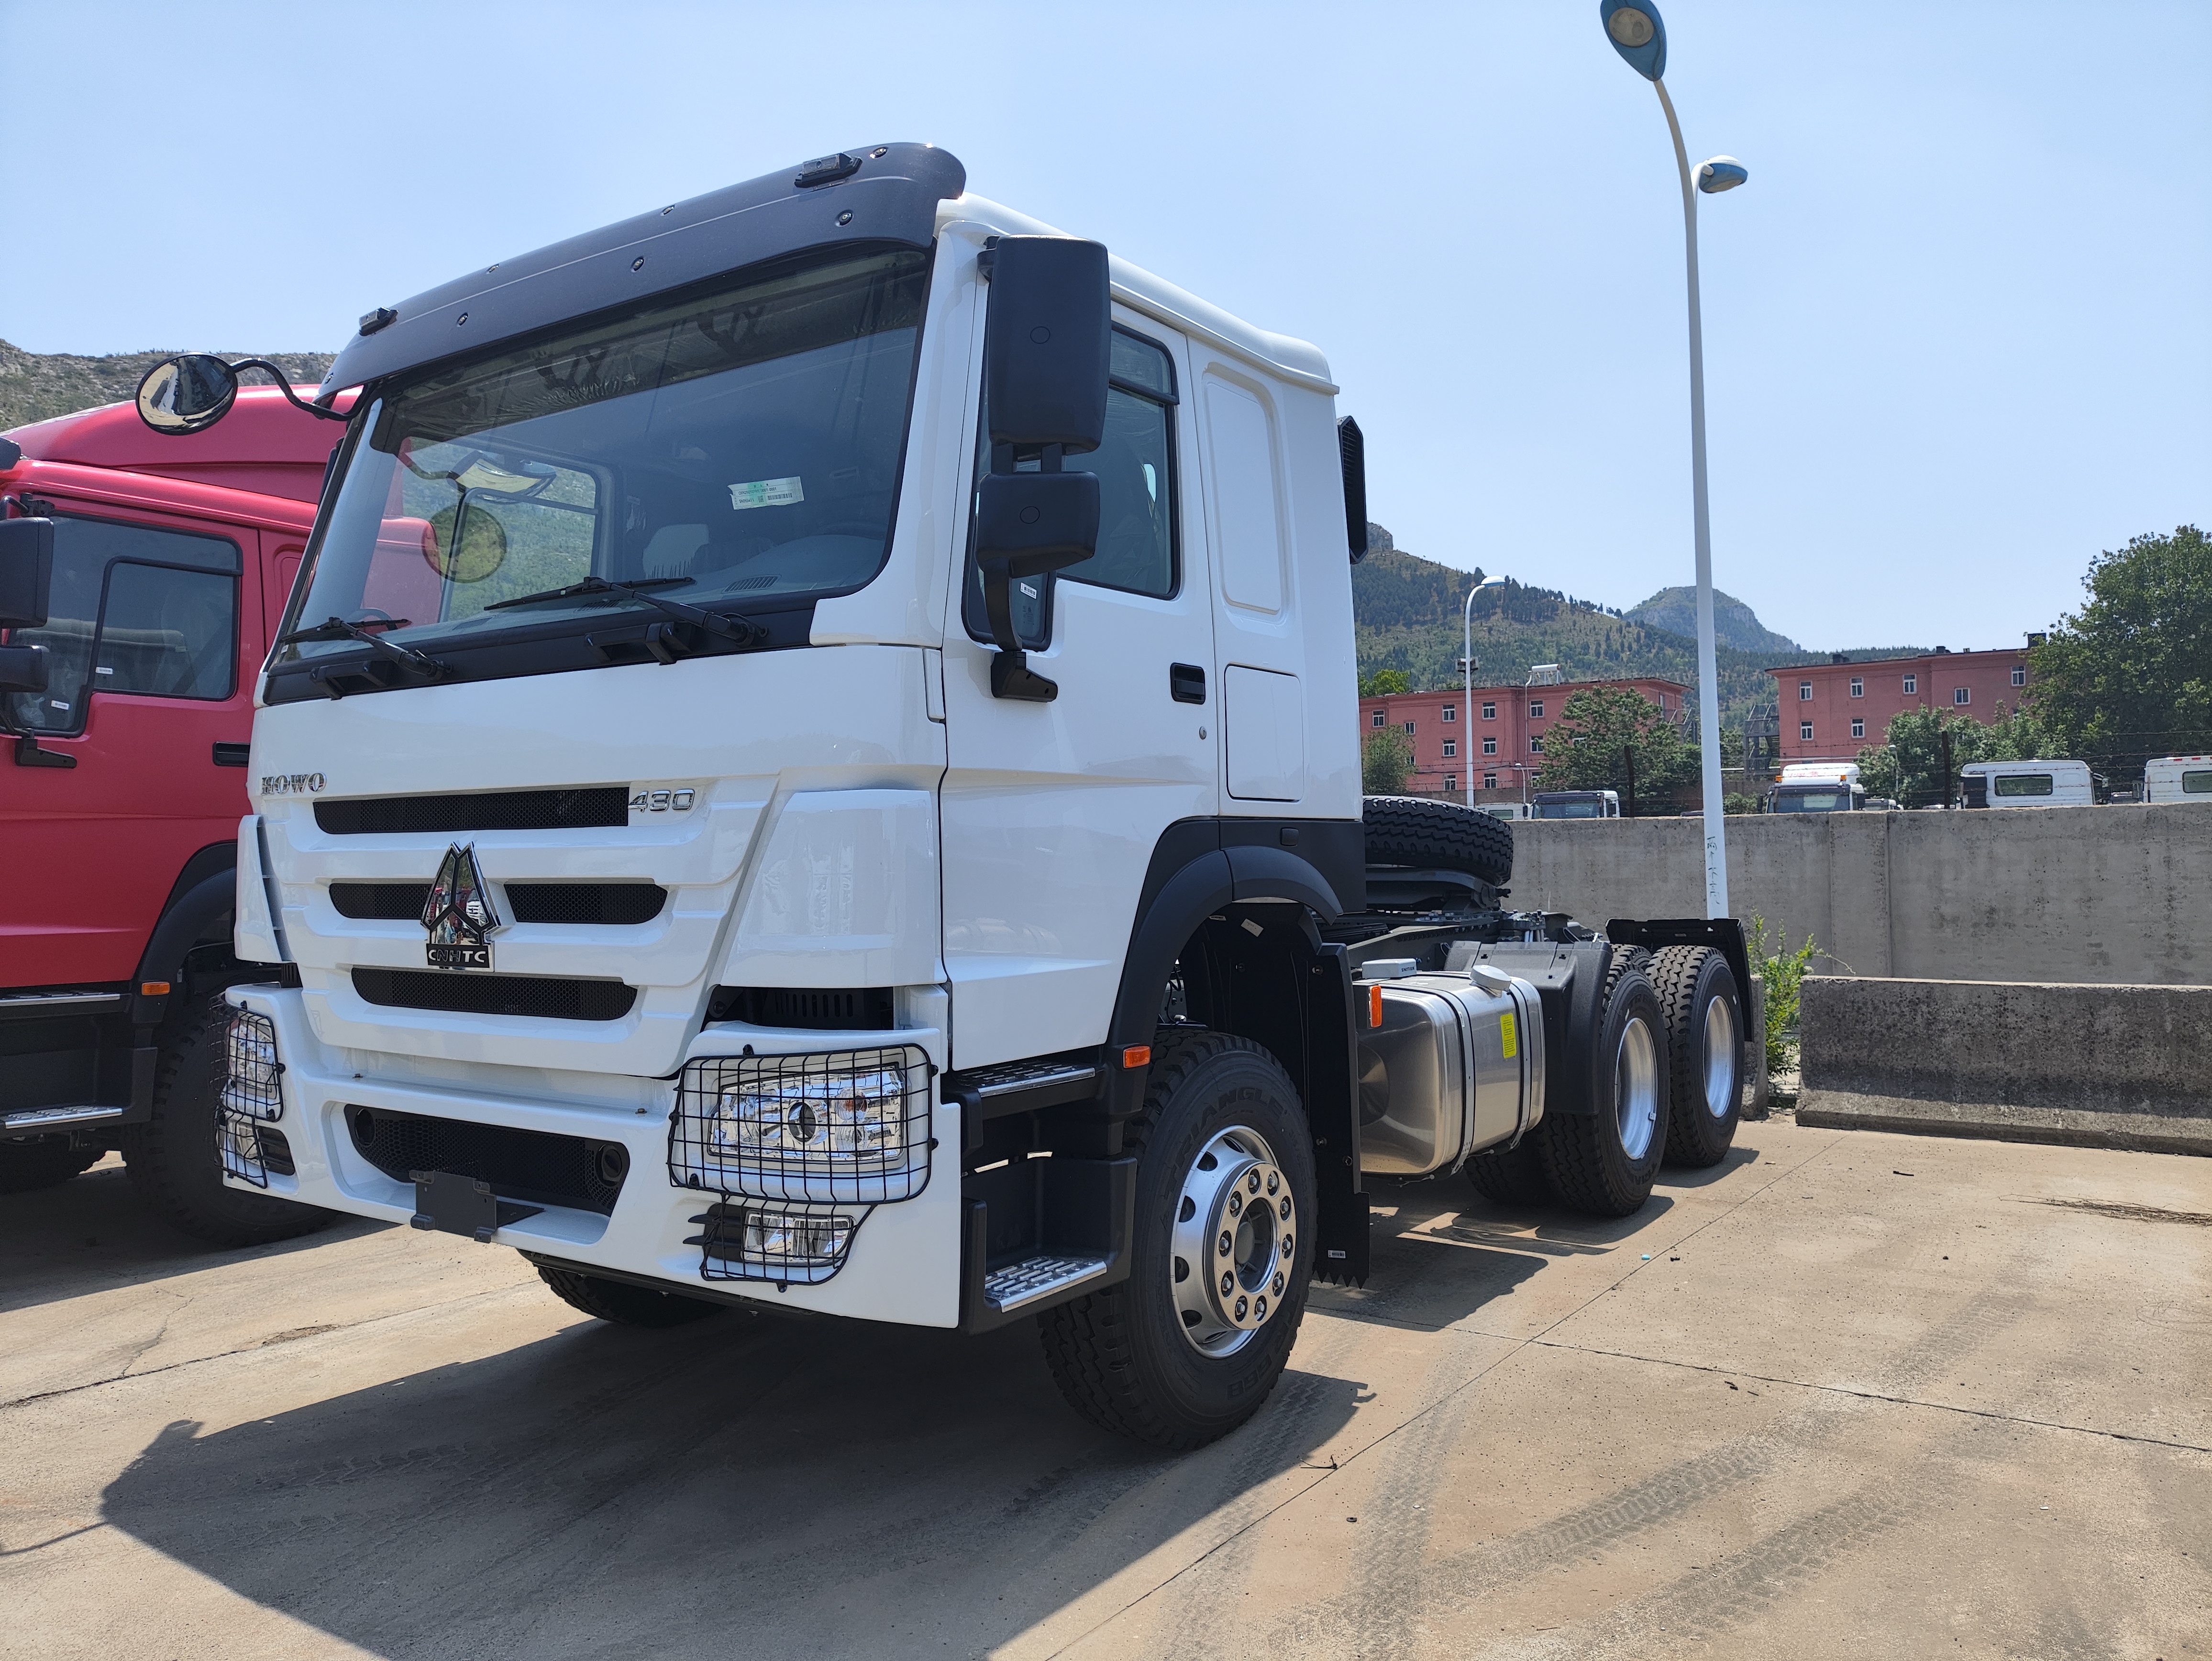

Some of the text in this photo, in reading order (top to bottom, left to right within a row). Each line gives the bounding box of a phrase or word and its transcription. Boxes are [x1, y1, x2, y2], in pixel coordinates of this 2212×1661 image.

[261, 772, 327, 796] HOWO
[628, 788, 695, 812] 430
[428, 949, 486, 963] CNHTC
[1161, 1087, 1284, 1200] TRIANGLE
